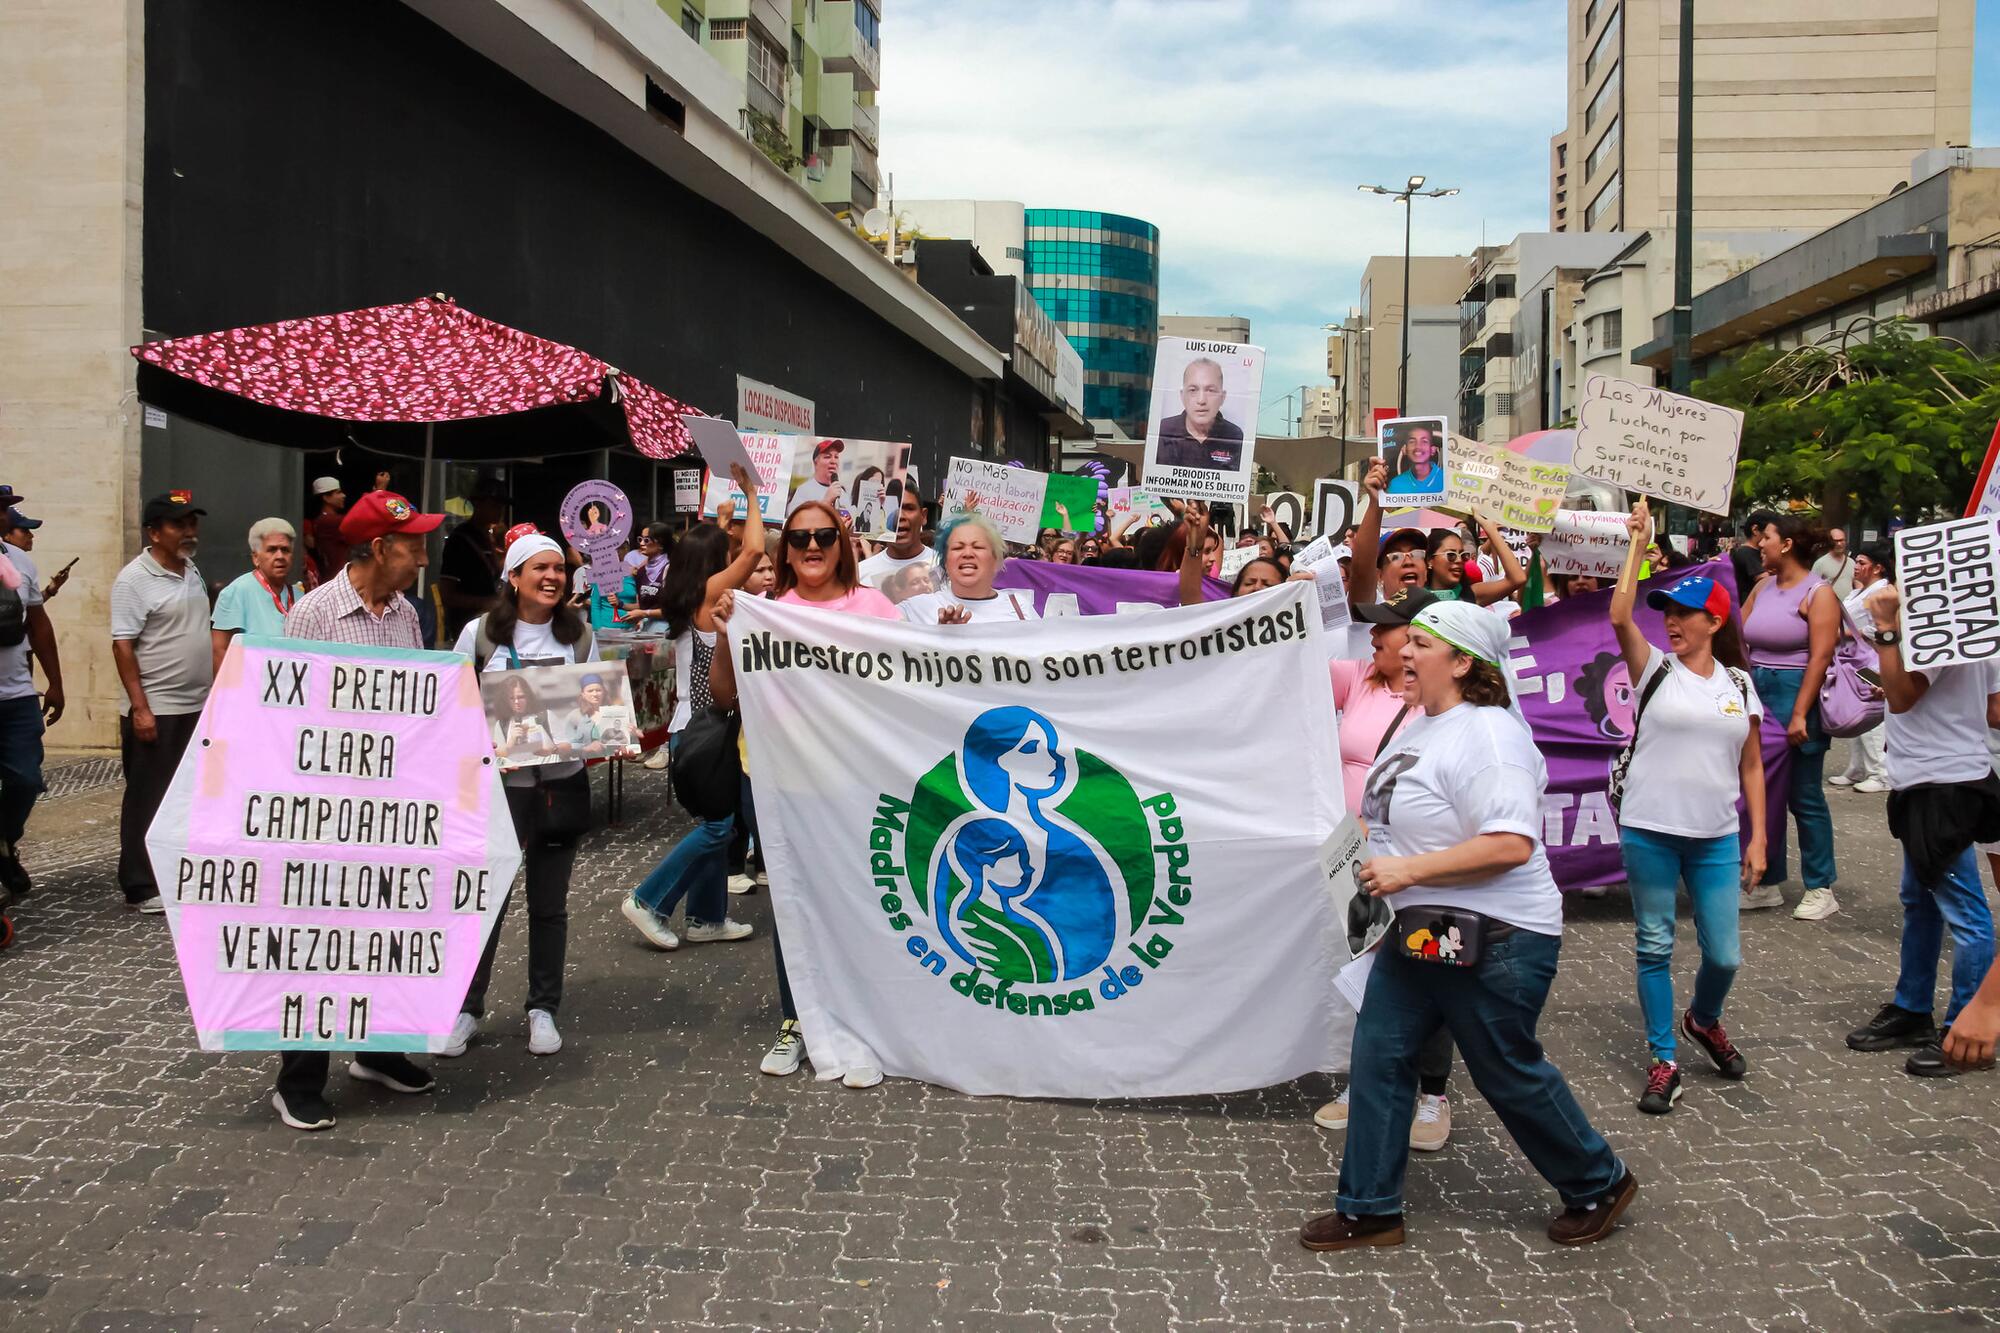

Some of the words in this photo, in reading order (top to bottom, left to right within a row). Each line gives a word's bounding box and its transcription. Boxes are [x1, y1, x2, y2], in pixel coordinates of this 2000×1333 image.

[1186, 342, 1205, 352] LUIS
[1208, 343, 1237, 354] LOPEZ
[744, 389, 773, 417] LOCALES
[774, 398, 811, 430] DISPONIBLES
[1600, 381, 1633, 403] Las
[1643, 392, 1707, 421] Mujeres
[767, 438, 778, 449] LA
[1609, 408, 1671, 437] Luchan
[1680, 431, 1706, 445] por
[1447, 437, 1494, 465] Quiero
[1504, 461, 1528, 473] que
[1619, 434, 1688, 463] Salarios
[956, 461, 973, 474] NO
[1145, 475, 1189, 488] INFORMAR
[1190, 480, 1203, 489] NO
[1205, 481, 1215, 490] ES
[1216, 482, 1245, 493] DELITO
[1173, 468, 1221, 481] PERIODISTA
[1447, 461, 1462, 470] as
[1542, 486, 1564, 496] que
[1582, 465, 1606, 478] Art
[1636, 474, 1652, 489] de
[1661, 481, 1706, 501] CBRV
[1006, 482, 1039, 501] laboral
[1144, 487, 1245, 500] #LIBERENALOSPRESOSPOLITICOS
[1386, 496, 1418, 504] ROINER
[1447, 490, 1489, 505] mbiar
[1492, 500, 1504, 510] el
[986, 508, 1024, 526] luchas
[1901, 531, 1955, 667] DERECHOS
[1946, 520, 2000, 659] LIBERTAD
[903, 651, 982, 688] hijos
[992, 655, 1031, 684] no
[1043, 653, 1104, 681] son
[1111, 602, 1307, 672] terroristas!
[264, 660, 308, 706] XX
[331, 666, 438, 716] PREMIO
[299, 729, 394, 778] CLARA
[246, 795, 439, 846] CAMPOAMOR
[869, 793, 913, 932] Madres
[1141, 791, 1193, 925] Verdad
[1328, 857, 1347, 880] ANGEL
[177, 857, 257, 903] PARA
[283, 862, 430, 910] MILLONES
[454, 869, 489, 911] DE
[223, 925, 442, 974] VENEZOLANAS
[906, 935, 947, 976] en
[1128, 933, 1175, 969] la
[950, 967, 1096, 1017] defensa
[1099, 965, 1144, 1001] de
